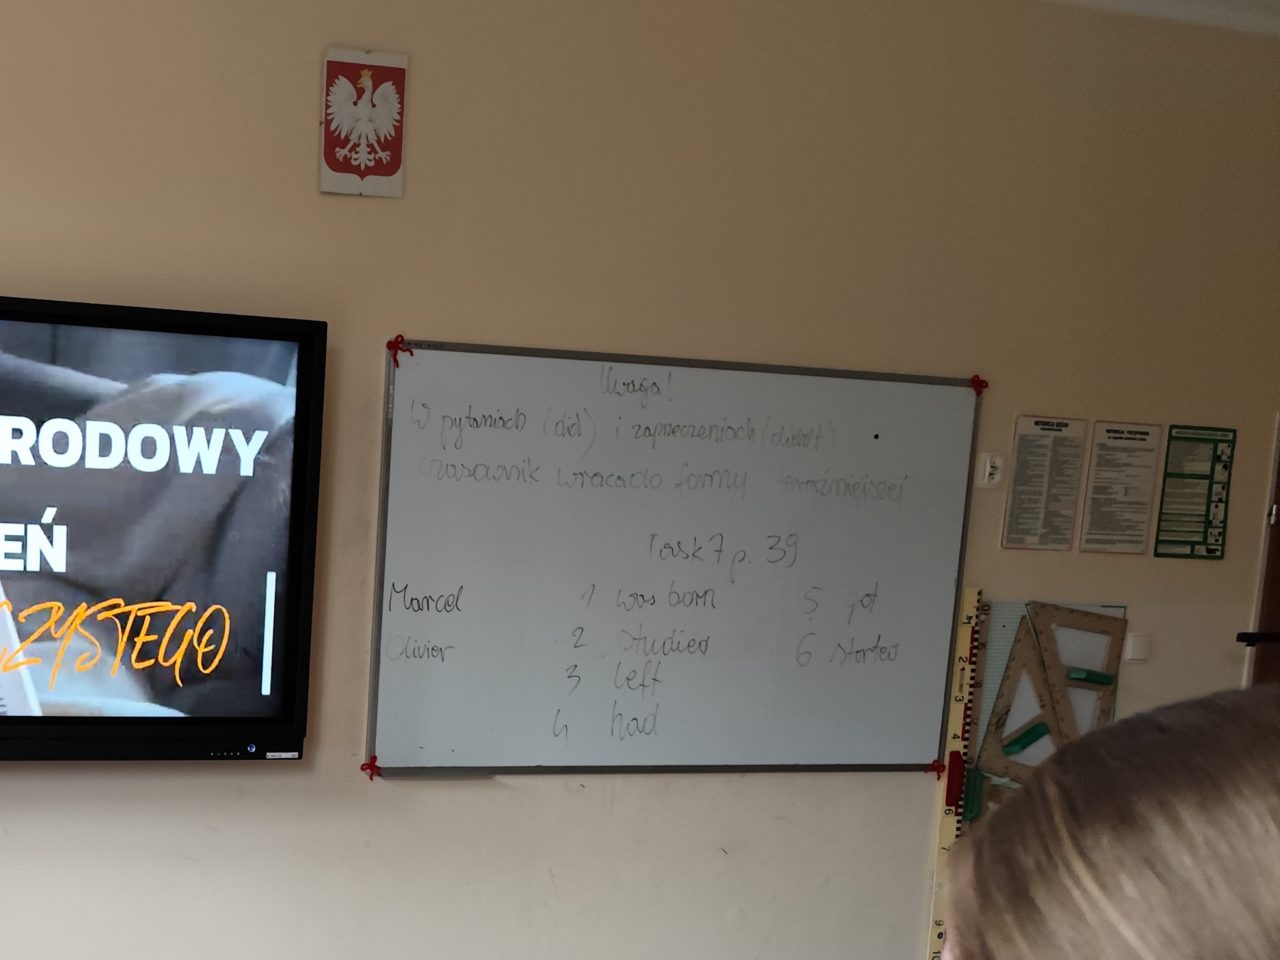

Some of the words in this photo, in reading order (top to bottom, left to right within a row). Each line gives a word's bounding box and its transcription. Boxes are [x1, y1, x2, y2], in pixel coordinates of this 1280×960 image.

[766, 532, 799, 568] 39
[388, 581, 464, 614] Marcel
[668, 580, 717, 609] born
[572, 627, 585, 648] 2
[796, 632, 816, 668] 6
[565, 664, 581, 695] 3
